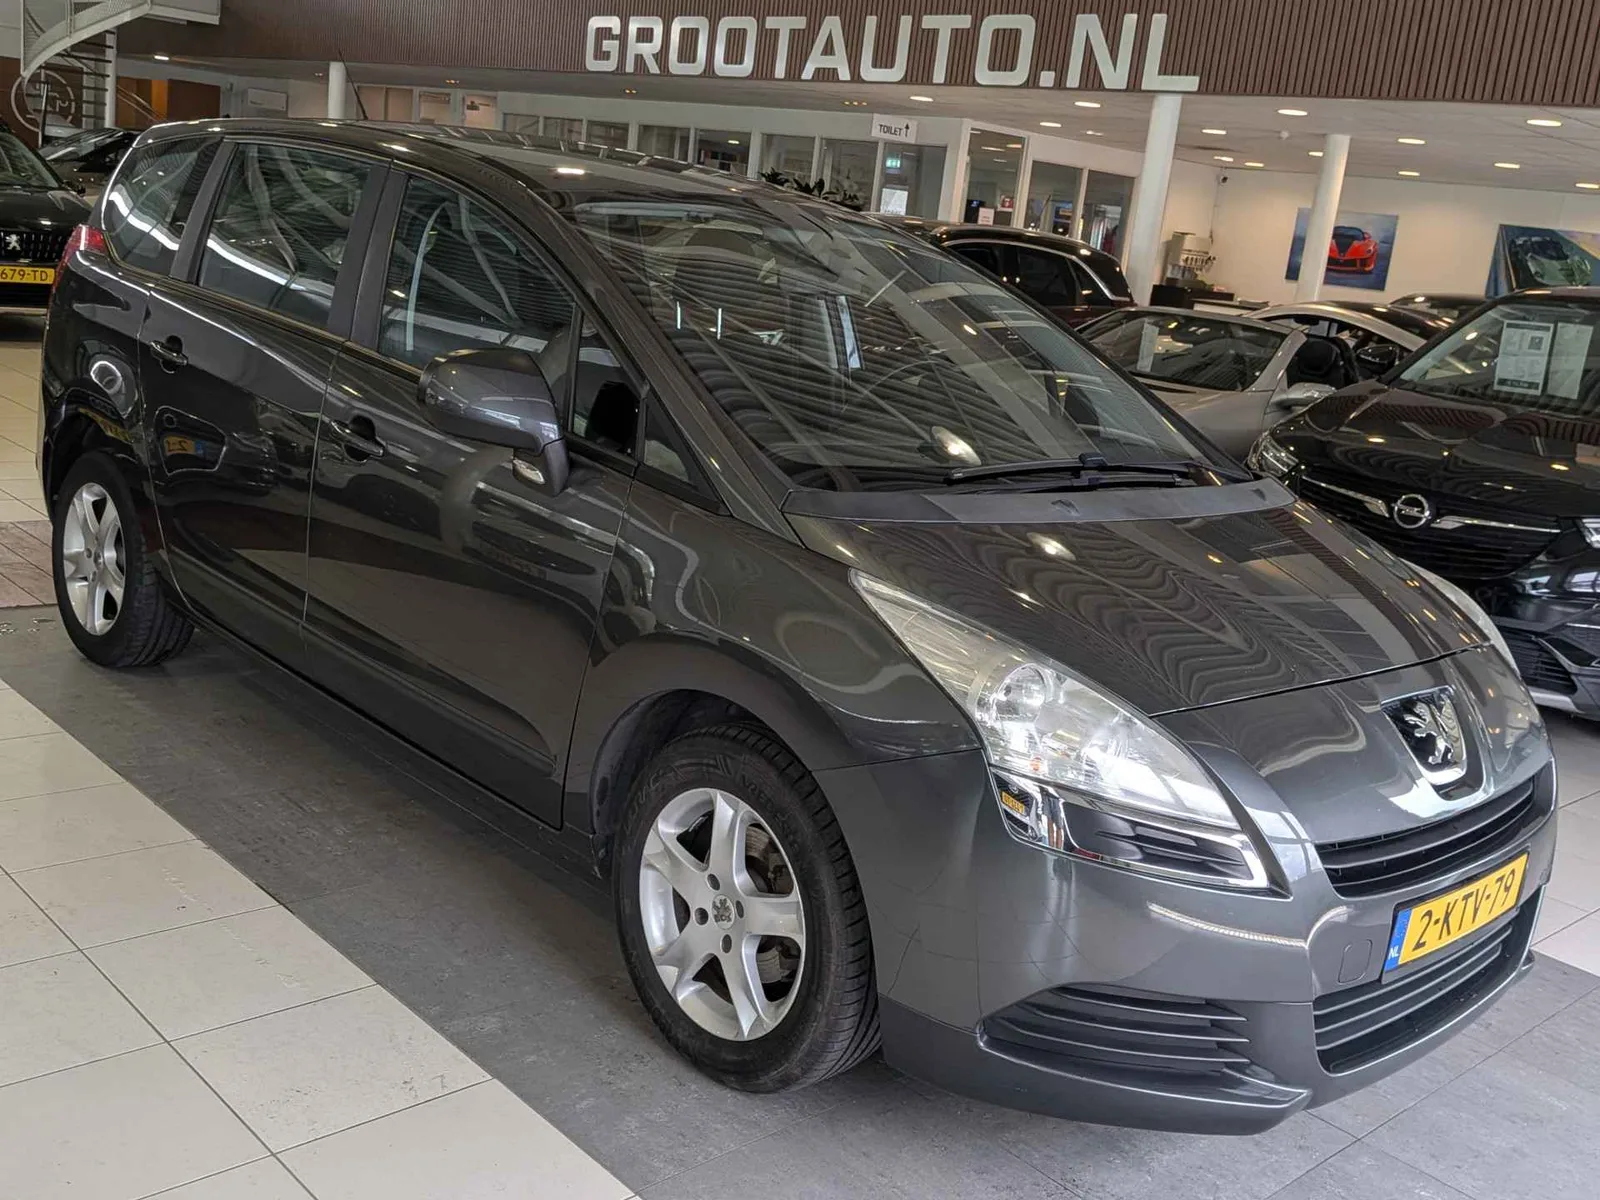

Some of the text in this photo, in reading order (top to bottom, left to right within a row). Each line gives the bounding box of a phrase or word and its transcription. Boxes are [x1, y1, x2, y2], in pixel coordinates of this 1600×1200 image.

[586, 13, 1200, 92] GROOTAUTO.NL
[878, 123, 903, 137] TOILET
[0, 268, 49, 281] 679-TD
[1412, 868, 1516, 952] 2-KTV-79
[1387, 946, 1399, 960] NL
